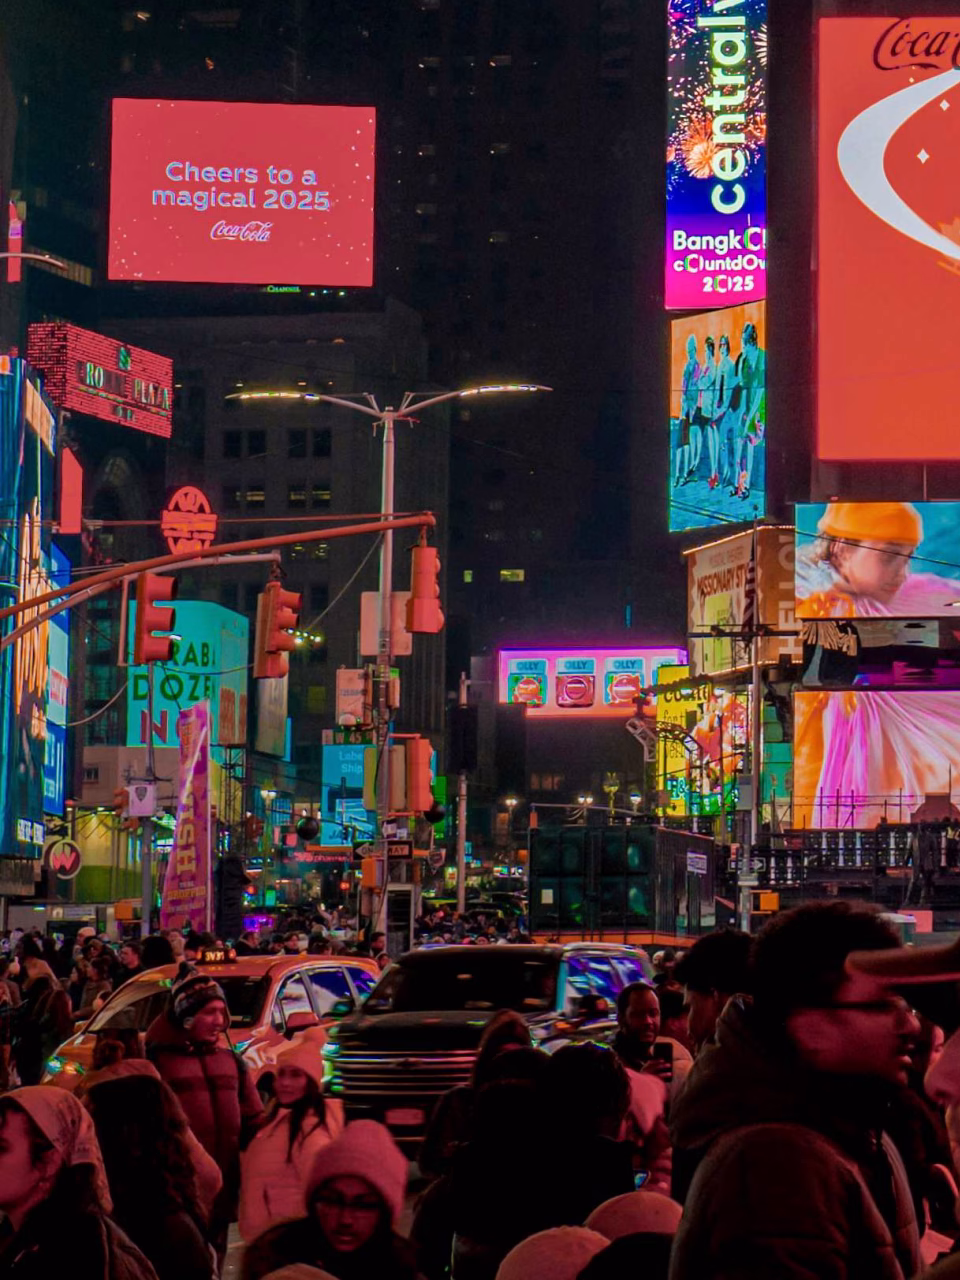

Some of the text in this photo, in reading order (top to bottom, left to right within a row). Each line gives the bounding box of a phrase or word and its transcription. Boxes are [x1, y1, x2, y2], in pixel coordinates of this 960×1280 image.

[165, 161, 317, 185] Cheers to a
[152, 187, 330, 211] magical 2025
[210, 220, 275, 242] Coca-Cola
[702, 274, 755, 293] 2025
[349, 732, 362, 744] 45
